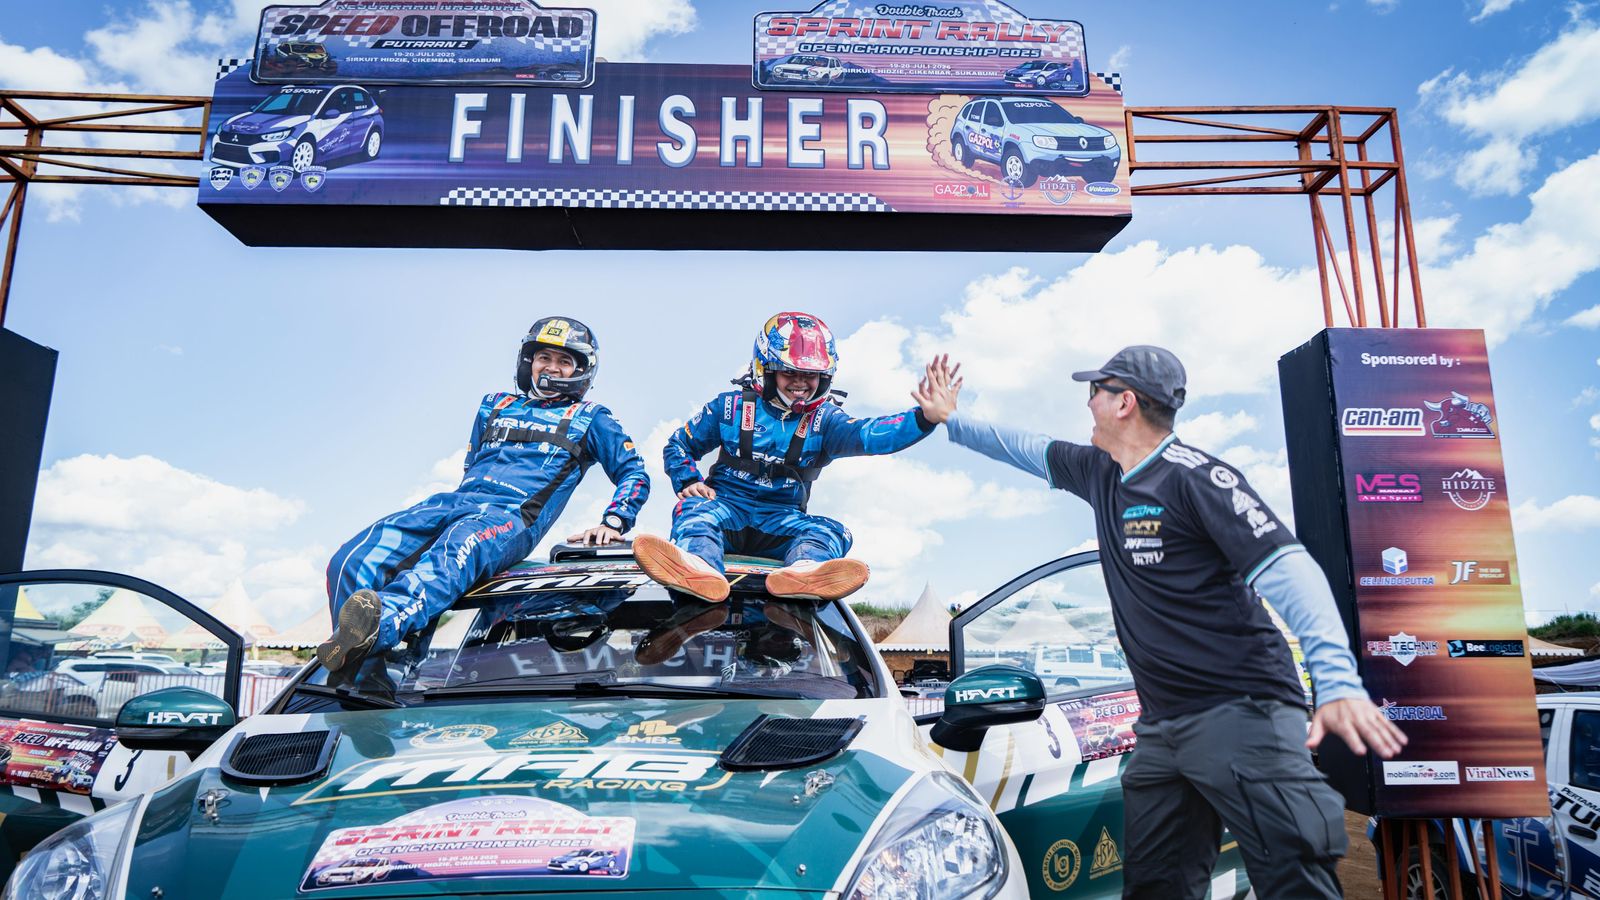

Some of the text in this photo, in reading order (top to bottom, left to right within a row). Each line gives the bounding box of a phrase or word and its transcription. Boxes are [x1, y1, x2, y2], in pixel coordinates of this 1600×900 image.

[440, 1, 525, 12] NASIONAL
[875, 4, 963, 19] Double Track
[271, 14, 584, 39] SPEED OFFROAD
[767, 17, 1070, 44] SPRINT RALLY
[381, 40, 457, 49] PUTARAN
[798, 43, 1043, 58] OPEN CHAMPIONSHIP 2025
[447, 93, 891, 170] FINISHER
[1039, 182, 1077, 191] HIDZIE
[1087, 185, 1120, 193] Volcano
[1360, 352, 1437, 367] Sponsored
[1439, 356, 1454, 368] by
[744, 405, 752, 428] SIMPSON
[1355, 473, 1422, 494] MES
[1442, 480, 1496, 490] HIDZIE
[1450, 560, 1479, 585] JF
[489, 572, 652, 594] MA
[1359, 576, 1435, 586] CELLINDO PUTRA
[1388, 706, 1447, 720] STARCOAL
[614, 735, 683, 745] BMB2
[29, 769, 54, 781] 2025
[1386, 769, 1456, 779] mobilinanews.com
[1467, 768, 1530, 779] ViralNews
[543, 778, 690, 792] RACING
[445, 811, 490, 823] Double
[334, 818, 624, 847] SPRINT RALLY
[355, 838, 594, 857] OPEN CHAMPIONSHIP 2025
